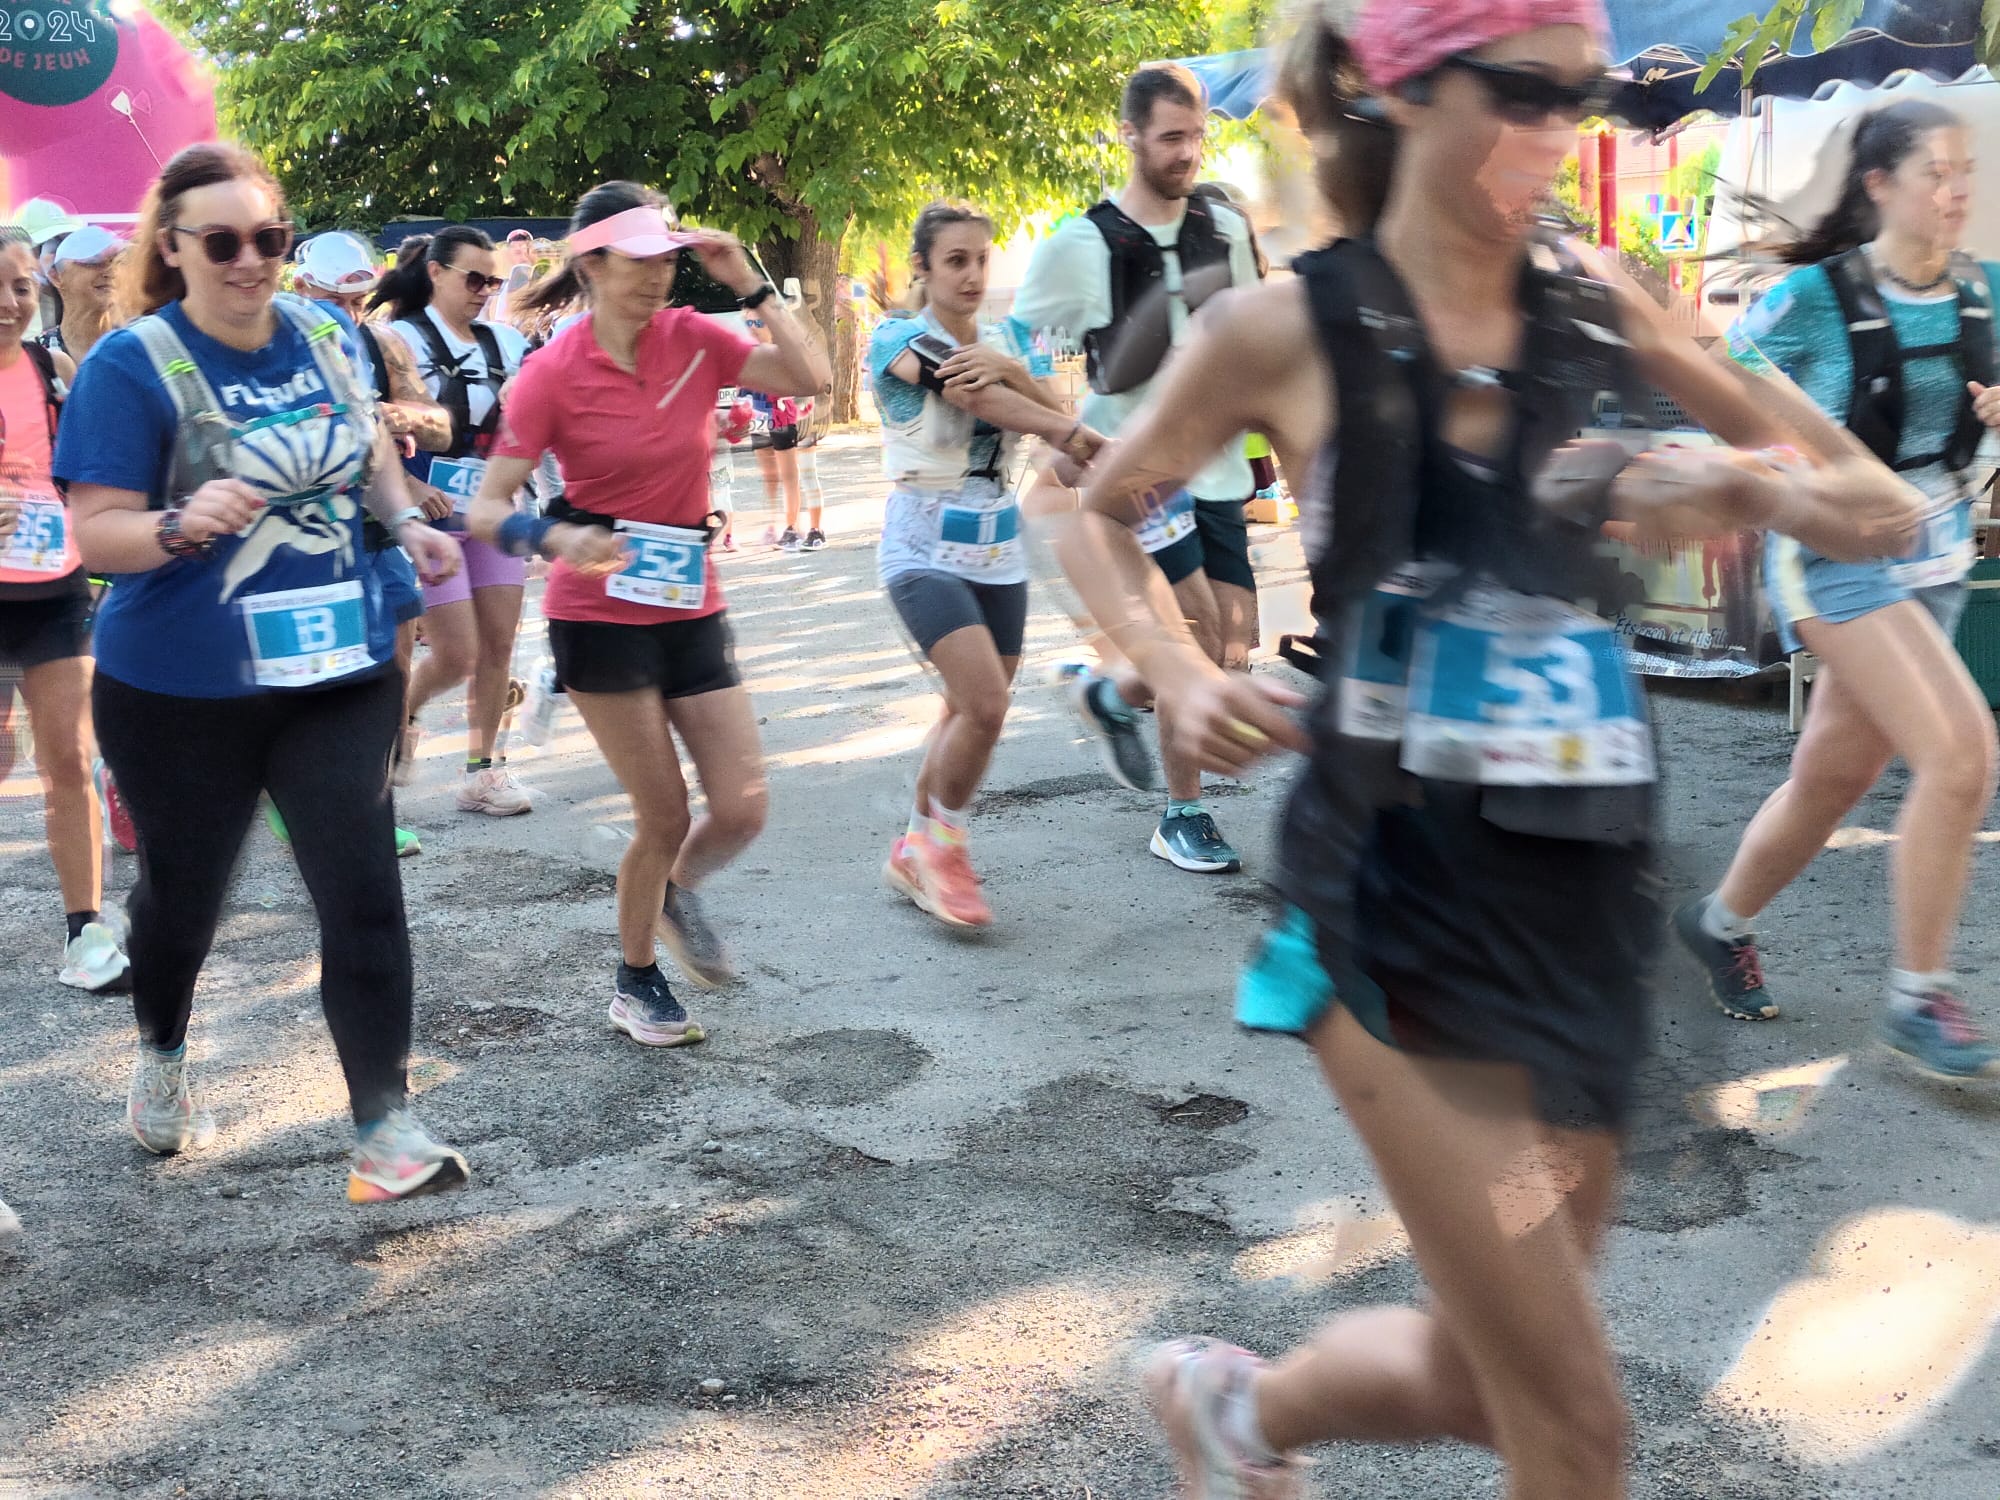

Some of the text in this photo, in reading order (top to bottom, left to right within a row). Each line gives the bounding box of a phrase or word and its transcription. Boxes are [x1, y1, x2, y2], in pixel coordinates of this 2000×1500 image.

[448, 467, 484, 496] 48
[638, 540, 692, 583] 52
[1477, 632, 1598, 729] 53
